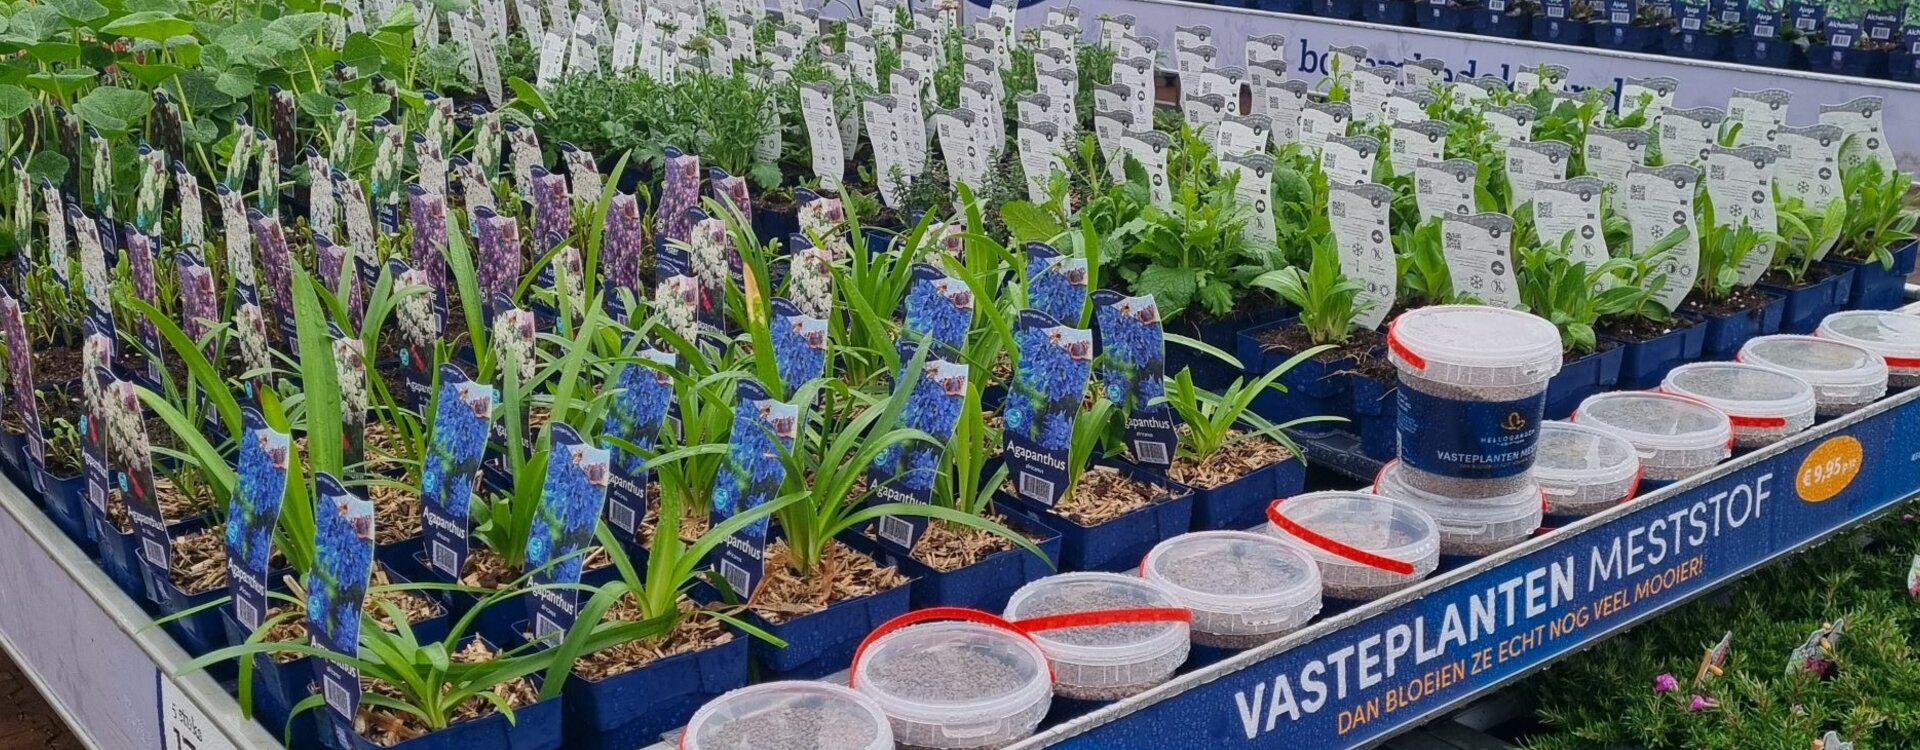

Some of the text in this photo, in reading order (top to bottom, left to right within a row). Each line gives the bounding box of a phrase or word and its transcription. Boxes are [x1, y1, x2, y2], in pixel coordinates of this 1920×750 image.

[1125, 415, 1171, 430] gapanthus
[1006, 440, 1066, 471] Agapanthus
[1436, 449, 1520, 464] VASTEPLANTEN
[1813, 456, 1841, 484] 9,95
[422, 505, 466, 540] Agapanthus
[227, 556, 265, 597] Agapanthus
[1234, 472, 1774, 740] VASTEPLANTEN MESTSTOF
[1337, 553, 1705, 736] DAN BLOEIEN ZE ECHT NOG VEEL MOOIER!
